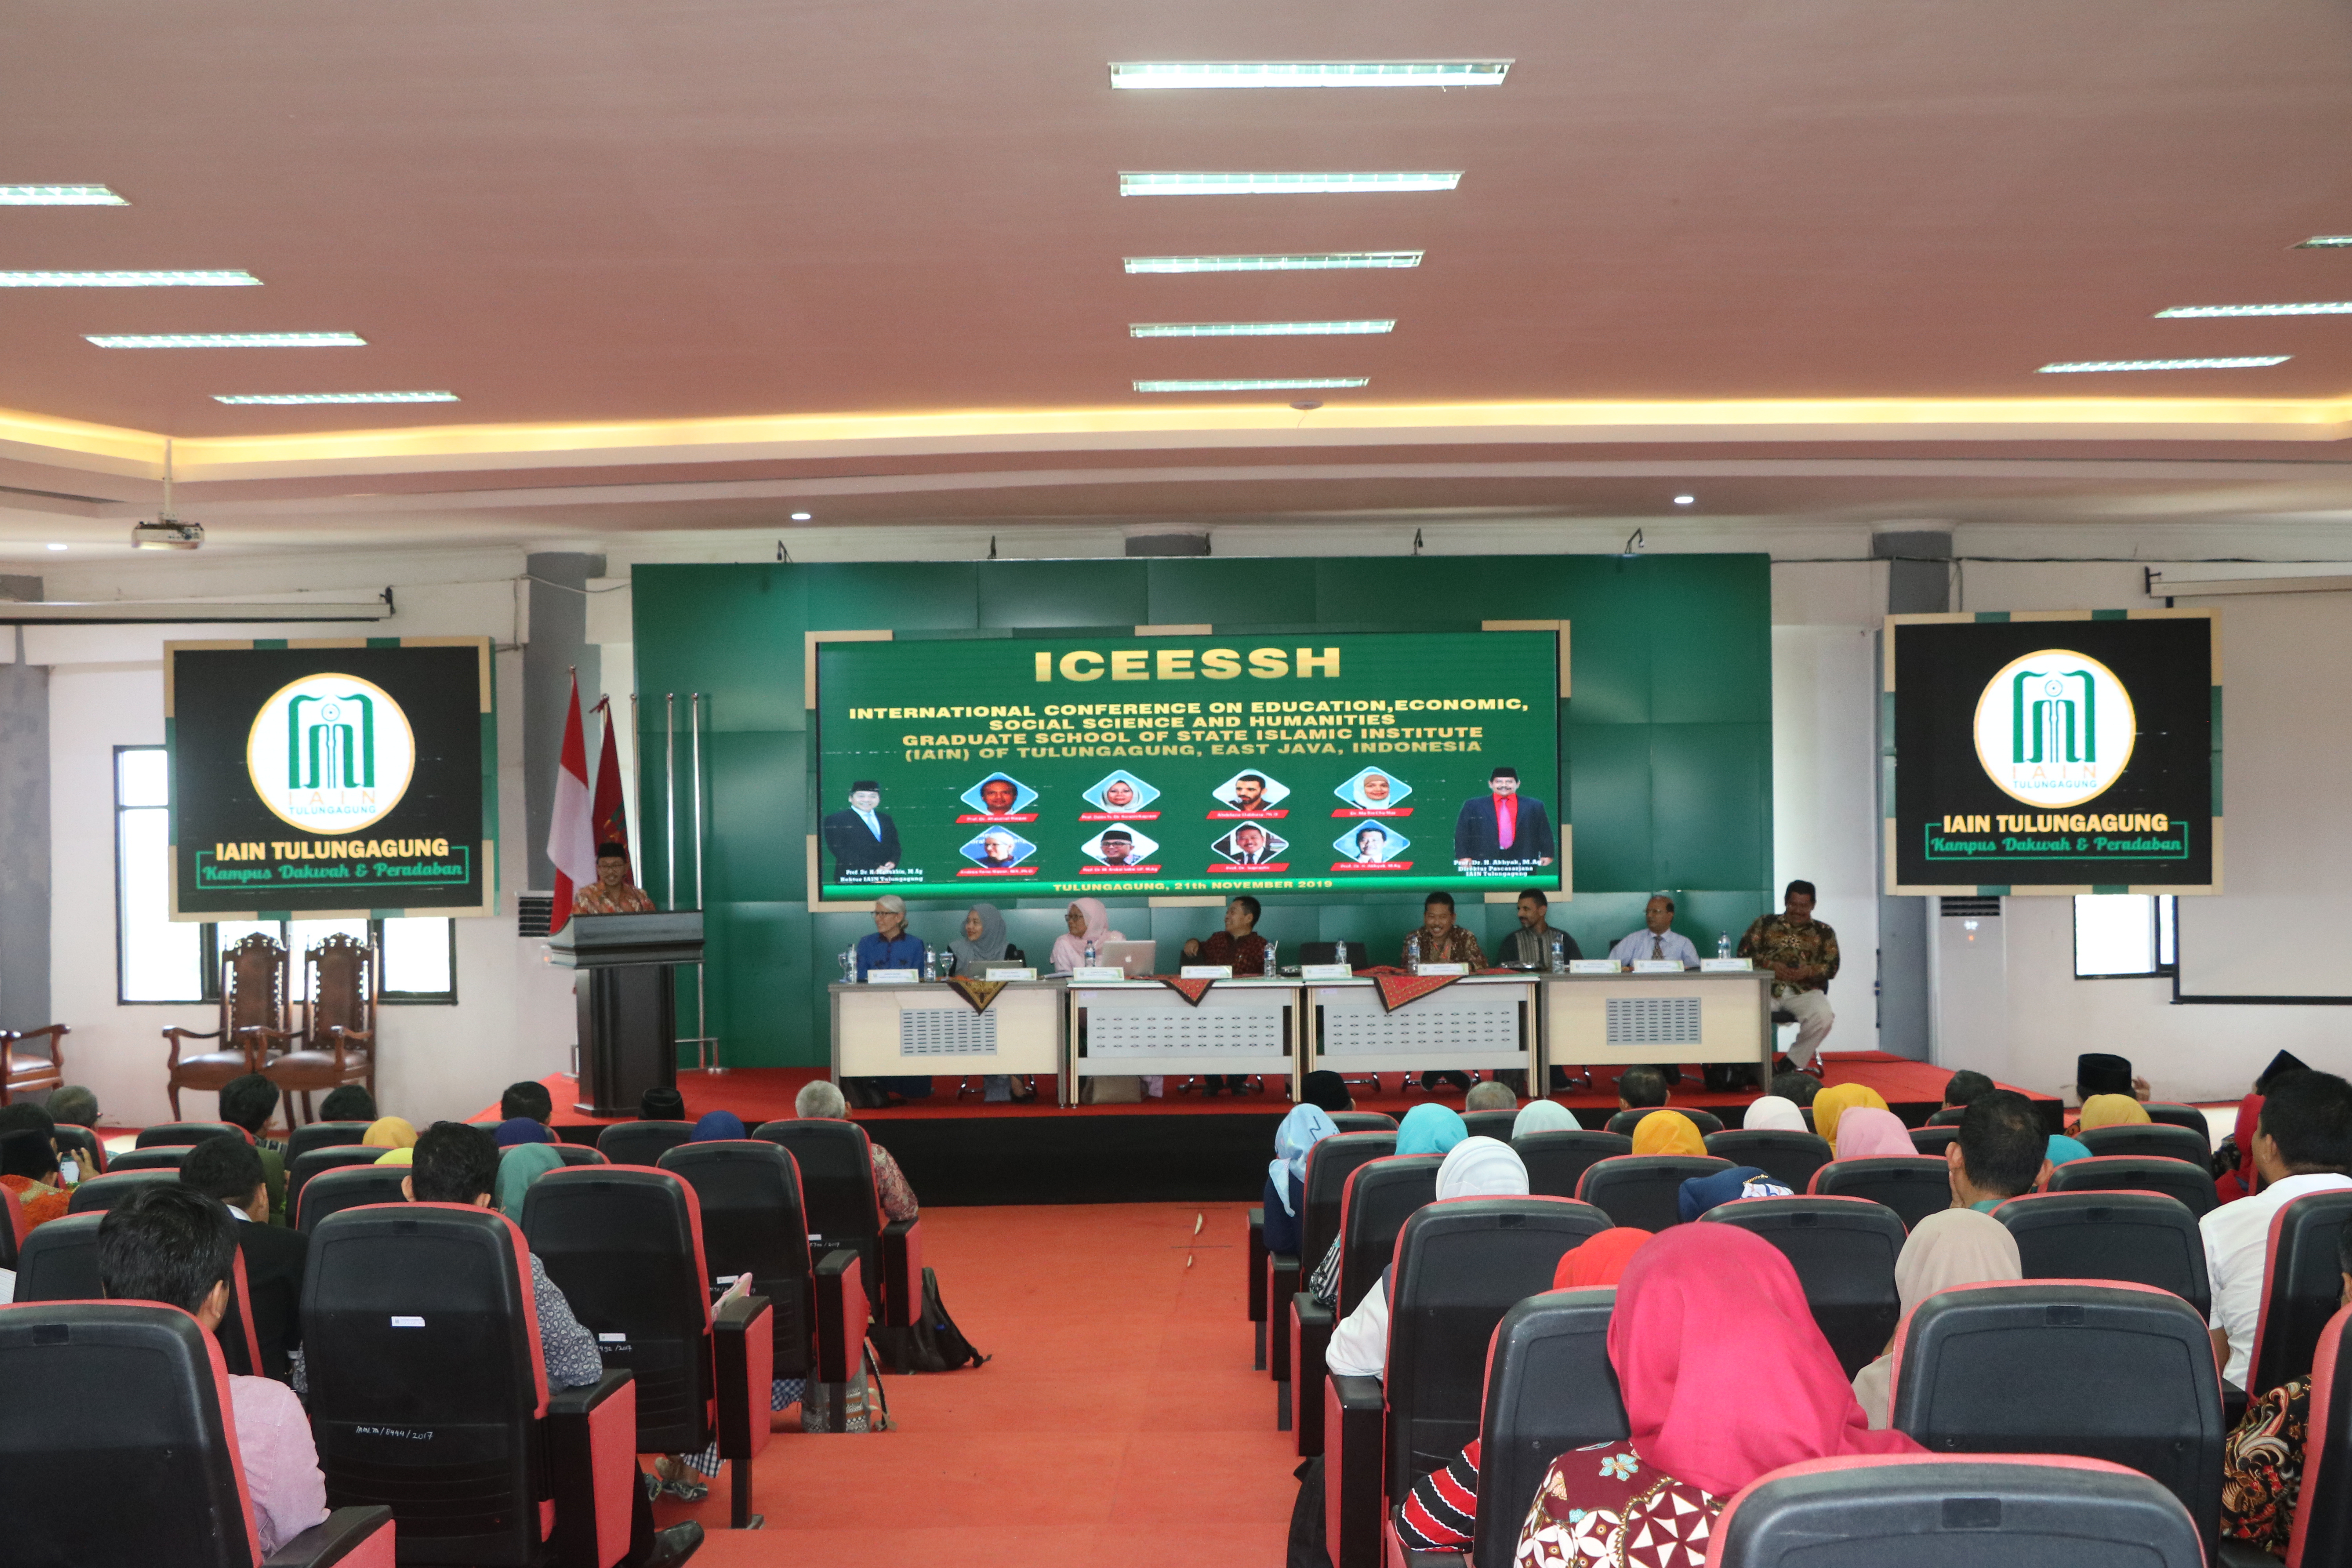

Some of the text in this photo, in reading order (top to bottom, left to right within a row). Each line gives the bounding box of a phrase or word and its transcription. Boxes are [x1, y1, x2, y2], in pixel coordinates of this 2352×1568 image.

[1035, 647, 1340, 682] ICEESSH
[849, 706, 1036, 719] INTERNATIONAL
[1044, 703, 1201, 716] CONFERENCE
[1209, 702, 1242, 713] ON
[989, 714, 1396, 731] SOCIAL SCIENCE AND HUMANITIES
[902, 727, 1483, 746] GRADUATE SCHOOL OF STATE ISLAMIC INSTITUTE
[905, 741, 1483, 762] (IAIN) OF TULUNGAGUNG, EAST JAVA, INDONESIA
[2013, 765, 2097, 779] IAIN
[2013, 780, 2097, 788] TULUNGAGUNG
[289, 790, 376, 805] IAIN
[289, 806, 376, 815] TULUNGAGUNG
[1943, 813, 2169, 833] IAIN TULUNGAGUNG
[216, 838, 450, 861] IAIN TULUNGAGUNG
[1931, 836, 2182, 855] Kampus Dakwah & Peradaban
[202, 862, 463, 883] Kampus Dakwah & Peradaban
[1053, 880, 1333, 891] TULUNGAGUNG, 21th NOVEMBER 2019
